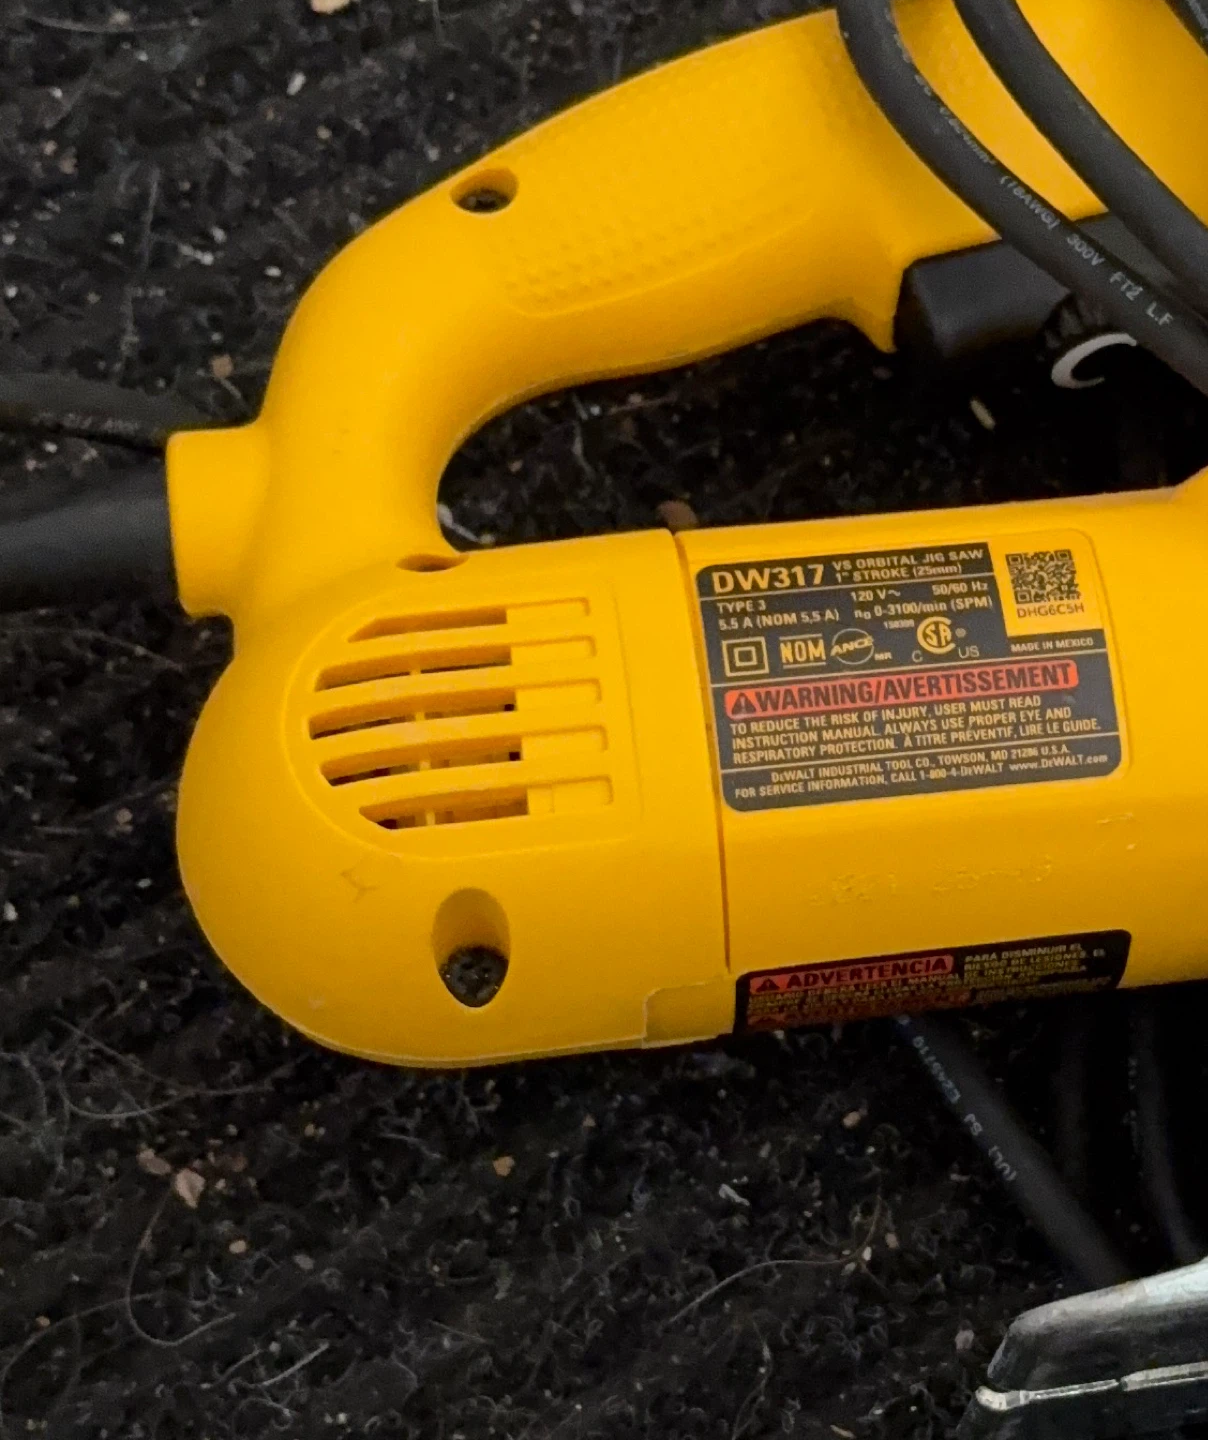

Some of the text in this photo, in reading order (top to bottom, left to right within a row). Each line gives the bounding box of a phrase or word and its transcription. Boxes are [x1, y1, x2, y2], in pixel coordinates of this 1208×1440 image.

[1066, 233, 1105, 266] 300V
[832, 549, 984, 571] VS ORBITAL JIG SAW
[712, 563, 824, 594] DW317
[852, 567, 911, 582] STROKE
[912, 563, 962, 578] (25mm)
[851, 590, 874, 602] 120
[931, 581, 989, 596] 50/60 Hz
[717, 600, 767, 614] TYPE 3
[873, 601, 948, 618] 0-3100/min
[950, 596, 993, 611] (SPM)
[719, 619, 739, 631] 5.5
[743, 616, 754, 628] A
[756, 612, 798, 628] (NOM
[825, 608, 840, 622] A)
[780, 639, 827, 663] NOM
[829, 634, 875, 657] ANCE
[958, 645, 980, 659] US
[1010, 637, 1094, 653] MADE IN MEXICO
[755, 662, 1071, 712] WARNING/AVERTISSEMENT
[730, 695, 1042, 735] TO REDUCE THE RISK OF INJURY, USER MUST READ
[732, 731, 819, 750] INSTRUCTION
[884, 718, 938, 735] ALWAYS
[941, 716, 965, 730] USE
[968, 711, 1017, 727] PROPER
[1019, 709, 1042, 723] EYE
[1045, 706, 1072, 720] AND
[733, 745, 816, 764] RESPIRATORY
[819, 737, 899, 756] PROTECTION.
[903, 732, 913, 748] À
[914, 732, 948, 747] TITRE
[1019, 723, 1044, 738] LIRE
[1046, 721, 1060, 734] LE
[1062, 718, 1102, 733] GUIDE.
[818, 762, 883, 778] INDUSTRIAL
[885, 759, 914, 771] TOOL
[991, 750, 1008, 761] MD
[1010, 747, 1039, 759] 21286
[1040, 744, 1071, 756] U.S.A.
[735, 786, 757, 798] FOR
[759, 782, 805, 797] SERVICE
[807, 773, 889, 792] INFORMATION,
[890, 770, 918, 783] CALL
[786, 957, 948, 990] ADVERTENCIA
